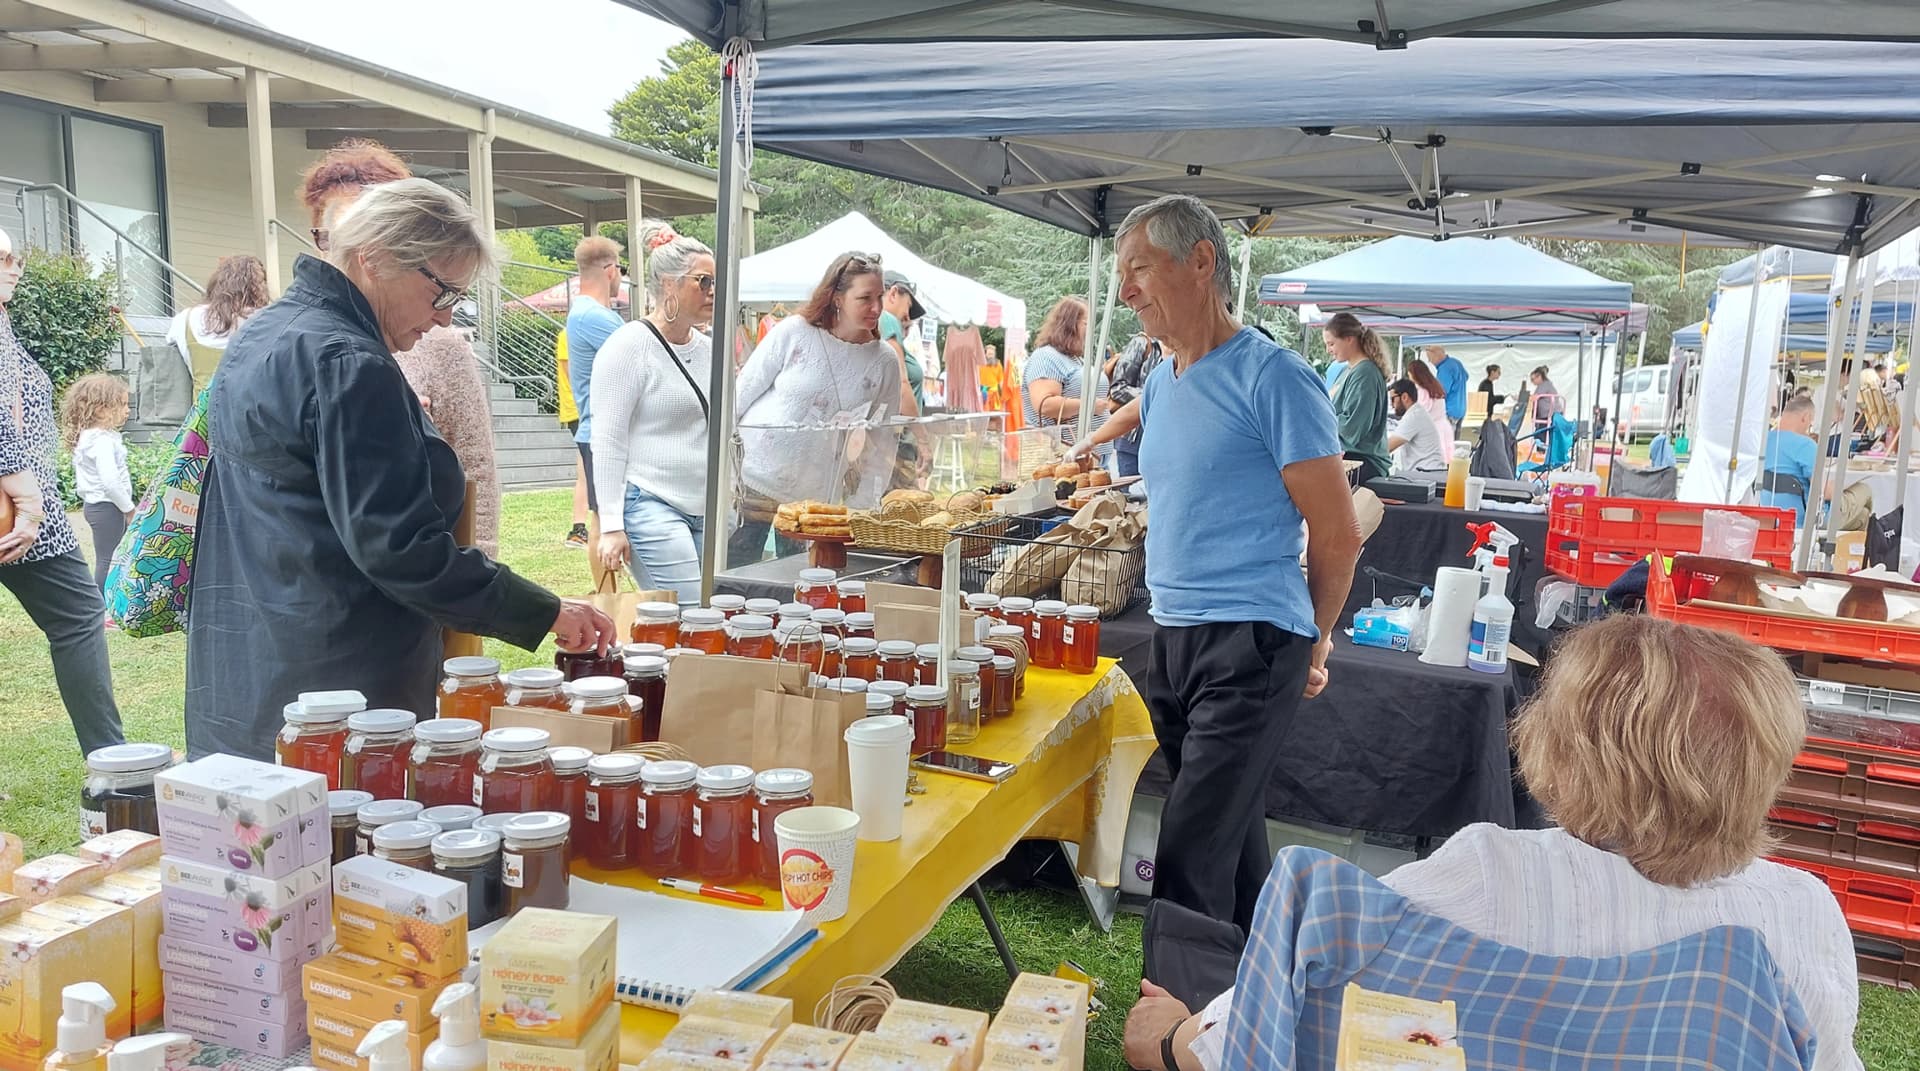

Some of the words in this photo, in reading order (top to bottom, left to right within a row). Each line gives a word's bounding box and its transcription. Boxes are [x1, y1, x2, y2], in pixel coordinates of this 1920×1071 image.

[1393, 636, 1406, 646] 100
[797, 873, 810, 882] HOT
[812, 871, 832, 881] CHIPS
[1139, 865, 1153, 878] 60
[310, 980, 352, 1000] LOZENGES
[314, 1016, 354, 1037] LOZENGES
[319, 1047, 358, 1068] LOZENGES
